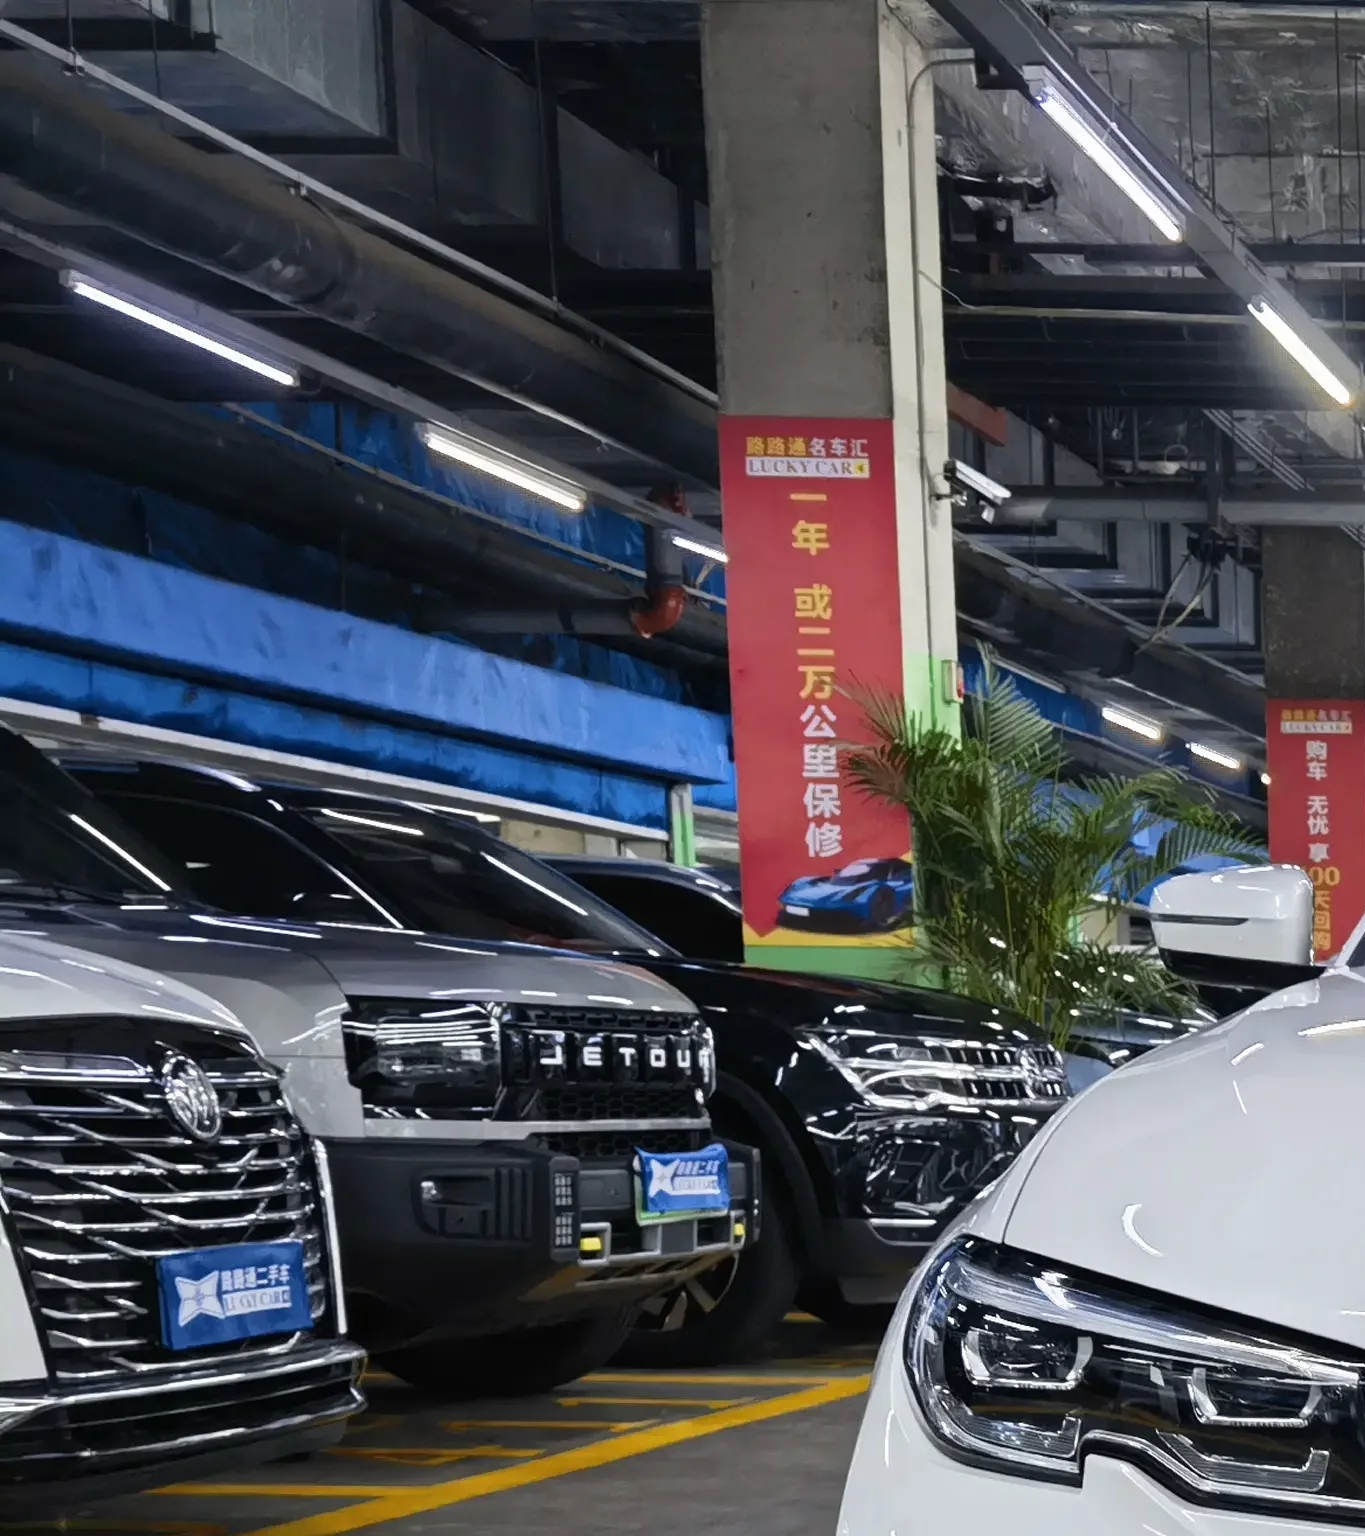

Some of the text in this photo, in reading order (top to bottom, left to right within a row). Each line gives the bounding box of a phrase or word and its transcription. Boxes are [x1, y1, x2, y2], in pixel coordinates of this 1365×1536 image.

[745, 436, 869, 457] 路路通名车汇
[748, 459, 853, 475] LUCKY CAR
